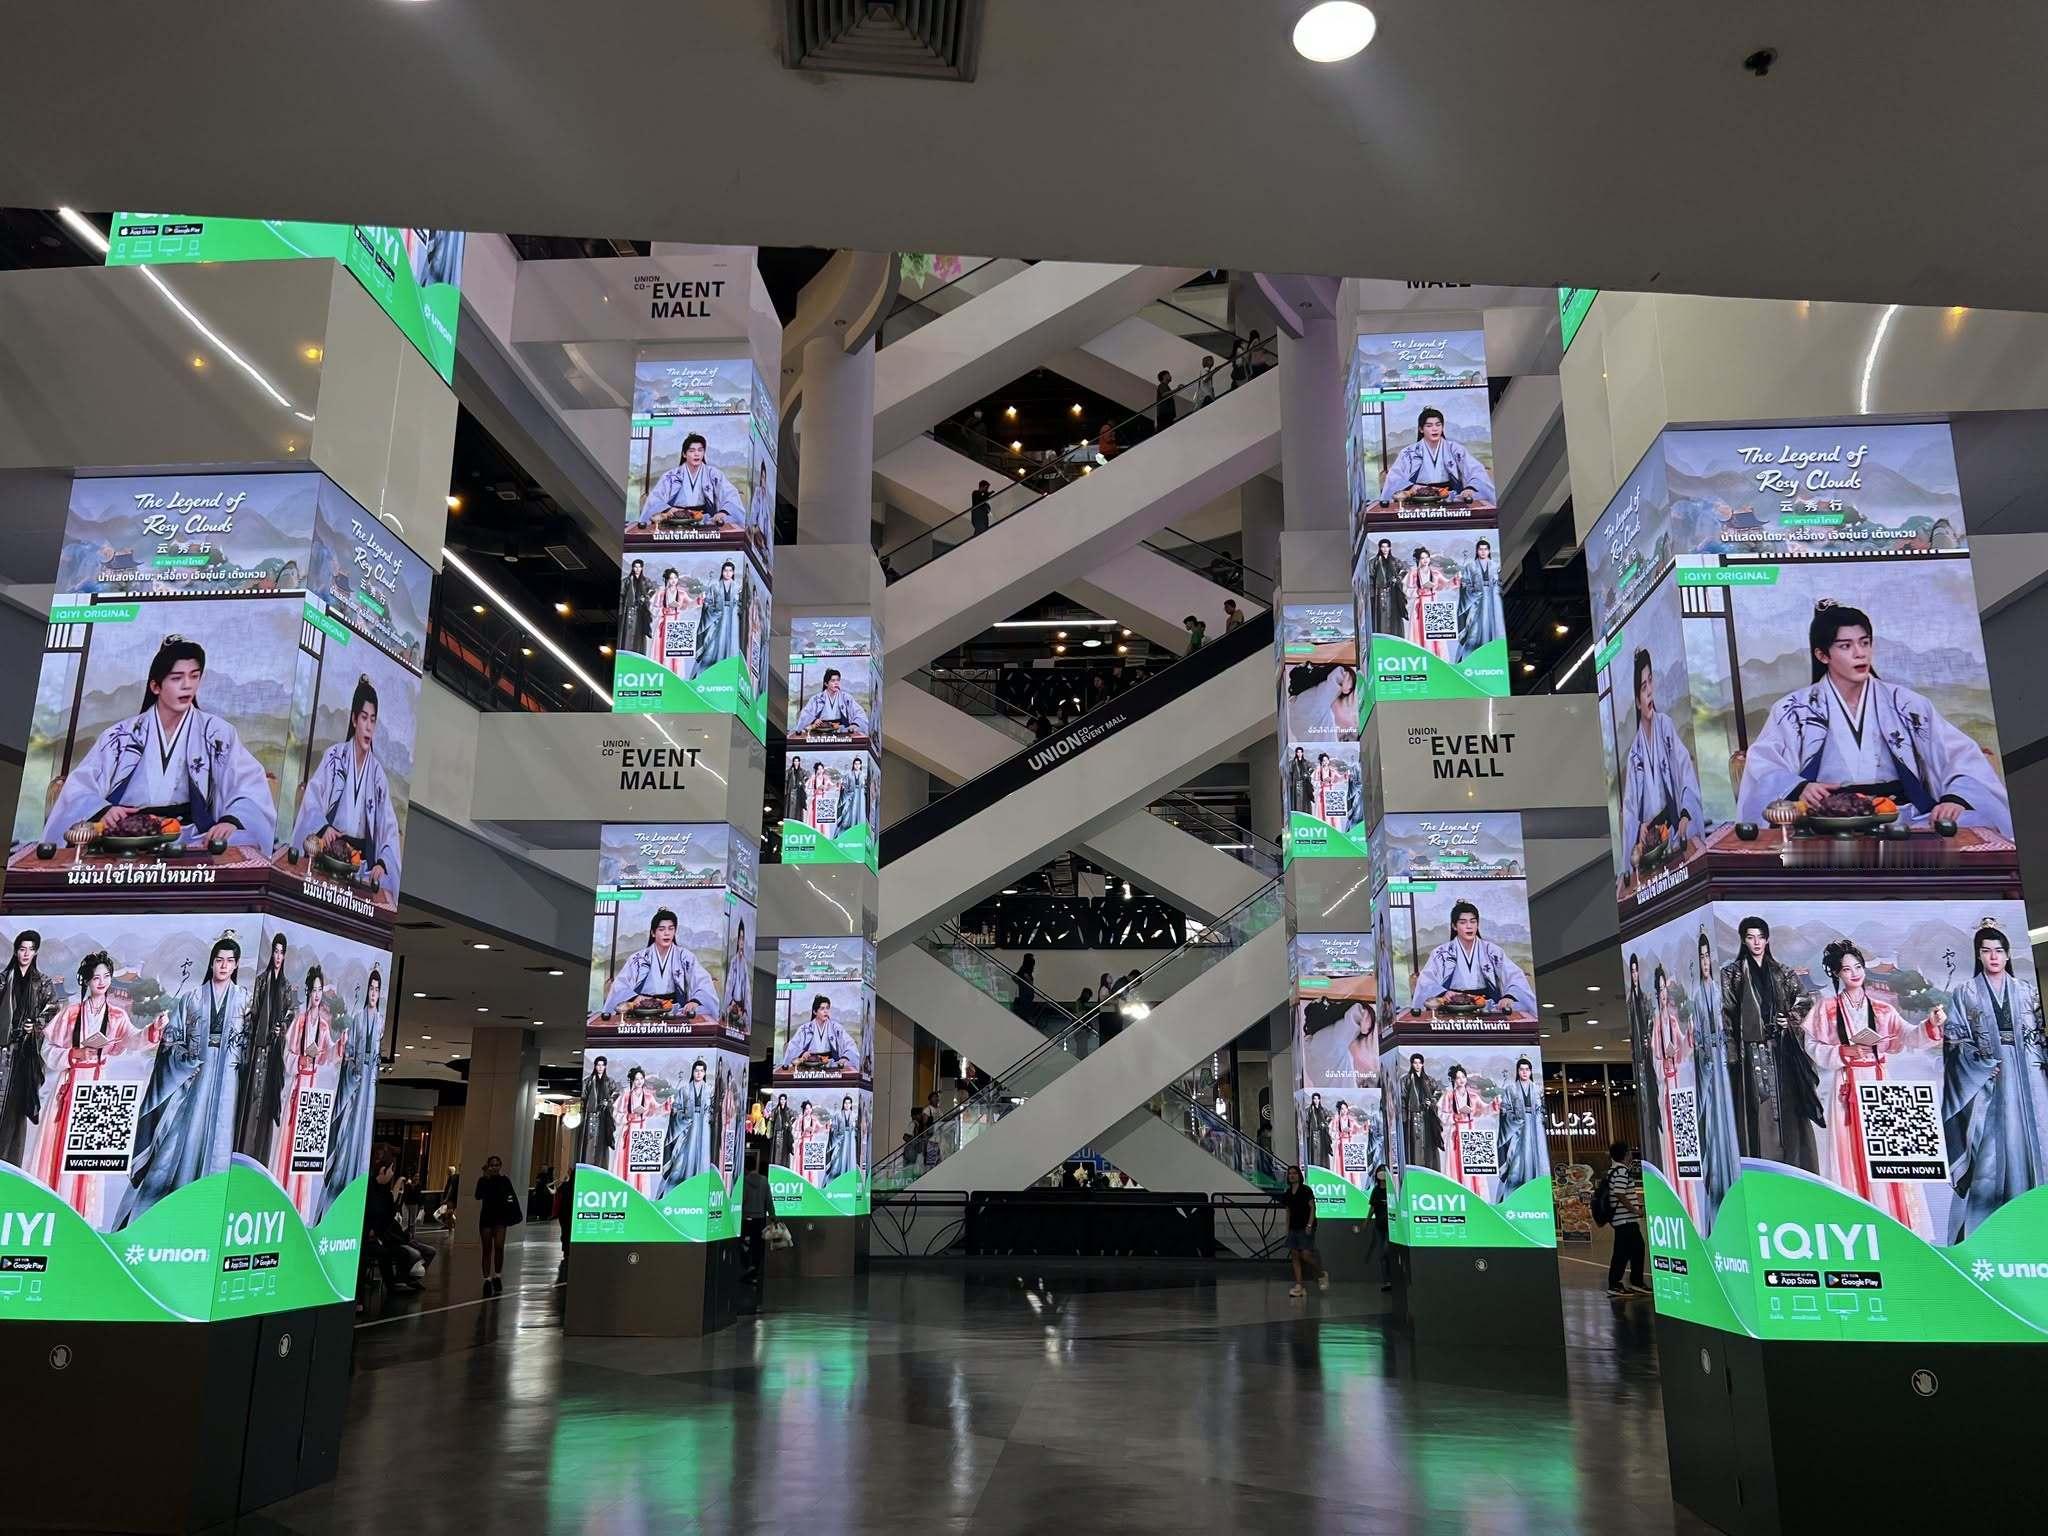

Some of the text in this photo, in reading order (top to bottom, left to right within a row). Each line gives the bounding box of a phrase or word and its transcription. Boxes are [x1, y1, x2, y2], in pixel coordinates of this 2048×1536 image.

[634, 275, 660, 283] UNION
[653, 281, 725, 299] EVENT
[651, 301, 711, 318] MALL
[1737, 445, 1868, 469] The Legend of
[1756, 469, 1862, 497] Rosy Clouds
[135, 491, 246, 514] The Legend of
[143, 514, 232, 540] Rosy Clouds
[352, 518, 403, 575] The Legend of
[1684, 570, 1770, 581] iQIYI ORIGINAL
[84, 608, 131, 619] ORIGINAL
[1377, 656, 1427, 671] iQIYI
[617, 673, 664, 688] iQIYI
[1082, 714, 1127, 743] EVENT MALL
[1408, 727, 1437, 735] UNION
[1028, 733, 1082, 770] UNION
[1431, 734, 1515, 755] EVENT
[622, 749, 701, 767] EVENT
[1433, 758, 1504, 779] MALL
[620, 771, 685, 790] MALL
[1294, 827, 1328, 837] iQIYI
[1420, 822, 1482, 835] The Legend of
[785, 835, 816, 844] iQIYI
[67, 859, 216, 885] นี่มันใช้ได้ที่ไหนกัน
[1545, 1112, 1595, 1127] しひろ
[70, 1159, 98, 1167] WATCH
[100, 1159, 119, 1167] NOW
[1876, 1166, 1909, 1175] WATCH
[1912, 1166, 1934, 1175] NOW
[577, 1191, 628, 1208] iQIYI
[1411, 1194, 1466, 1212] iQIYI
[0, 1212, 56, 1246] IYI
[225, 1211, 285, 1247] iQIYI
[1649, 1216, 1686, 1250] iQIYI
[329, 1238, 357, 1252] union
[1757, 1222, 1880, 1261] iQIYI
[148, 1248, 206, 1262] union
[13, 1262, 32, 1270] Google
[1723, 1257, 1749, 1273] union
[1998, 1263, 2048, 1278] unio
[1781, 1277, 1817, 1285] App Store
[1841, 1278, 1878, 1287] Google Play
